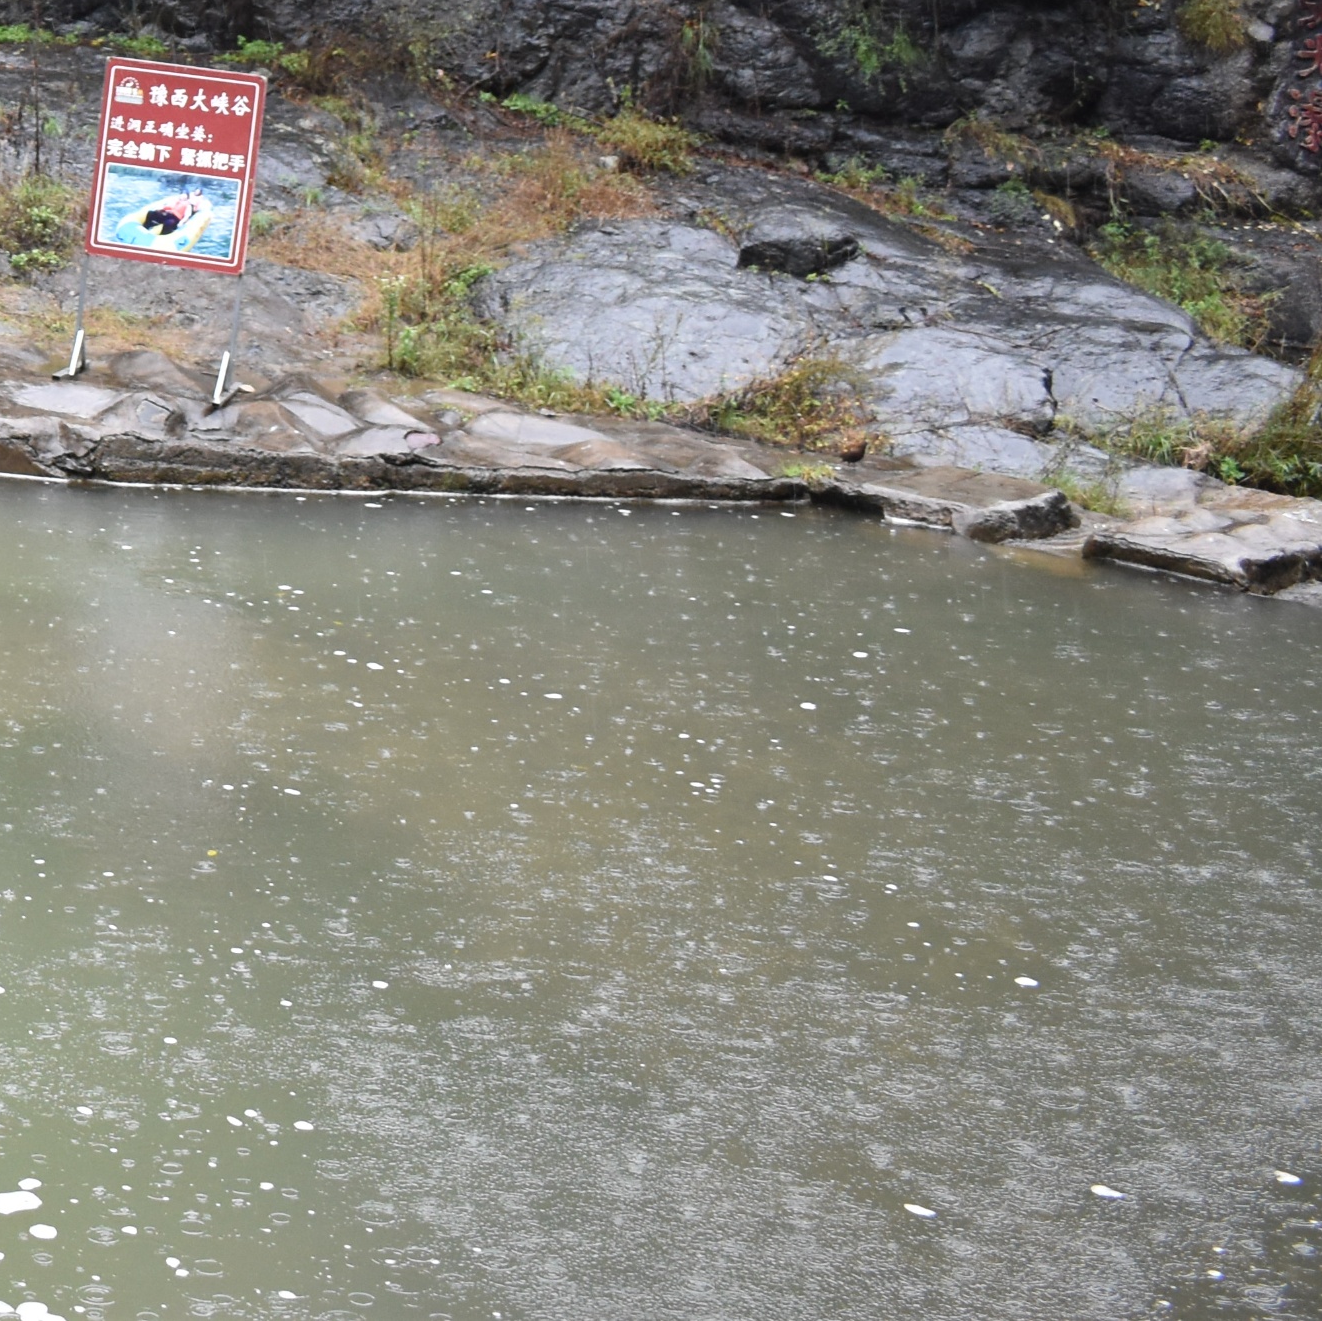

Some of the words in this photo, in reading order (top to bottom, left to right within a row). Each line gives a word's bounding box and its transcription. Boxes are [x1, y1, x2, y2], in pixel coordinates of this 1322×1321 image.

[149, 83, 251, 116] 豫西大峡谷
[107, 138, 172, 162] 完全躺下
[180, 148, 245, 172] 紧抓把手
